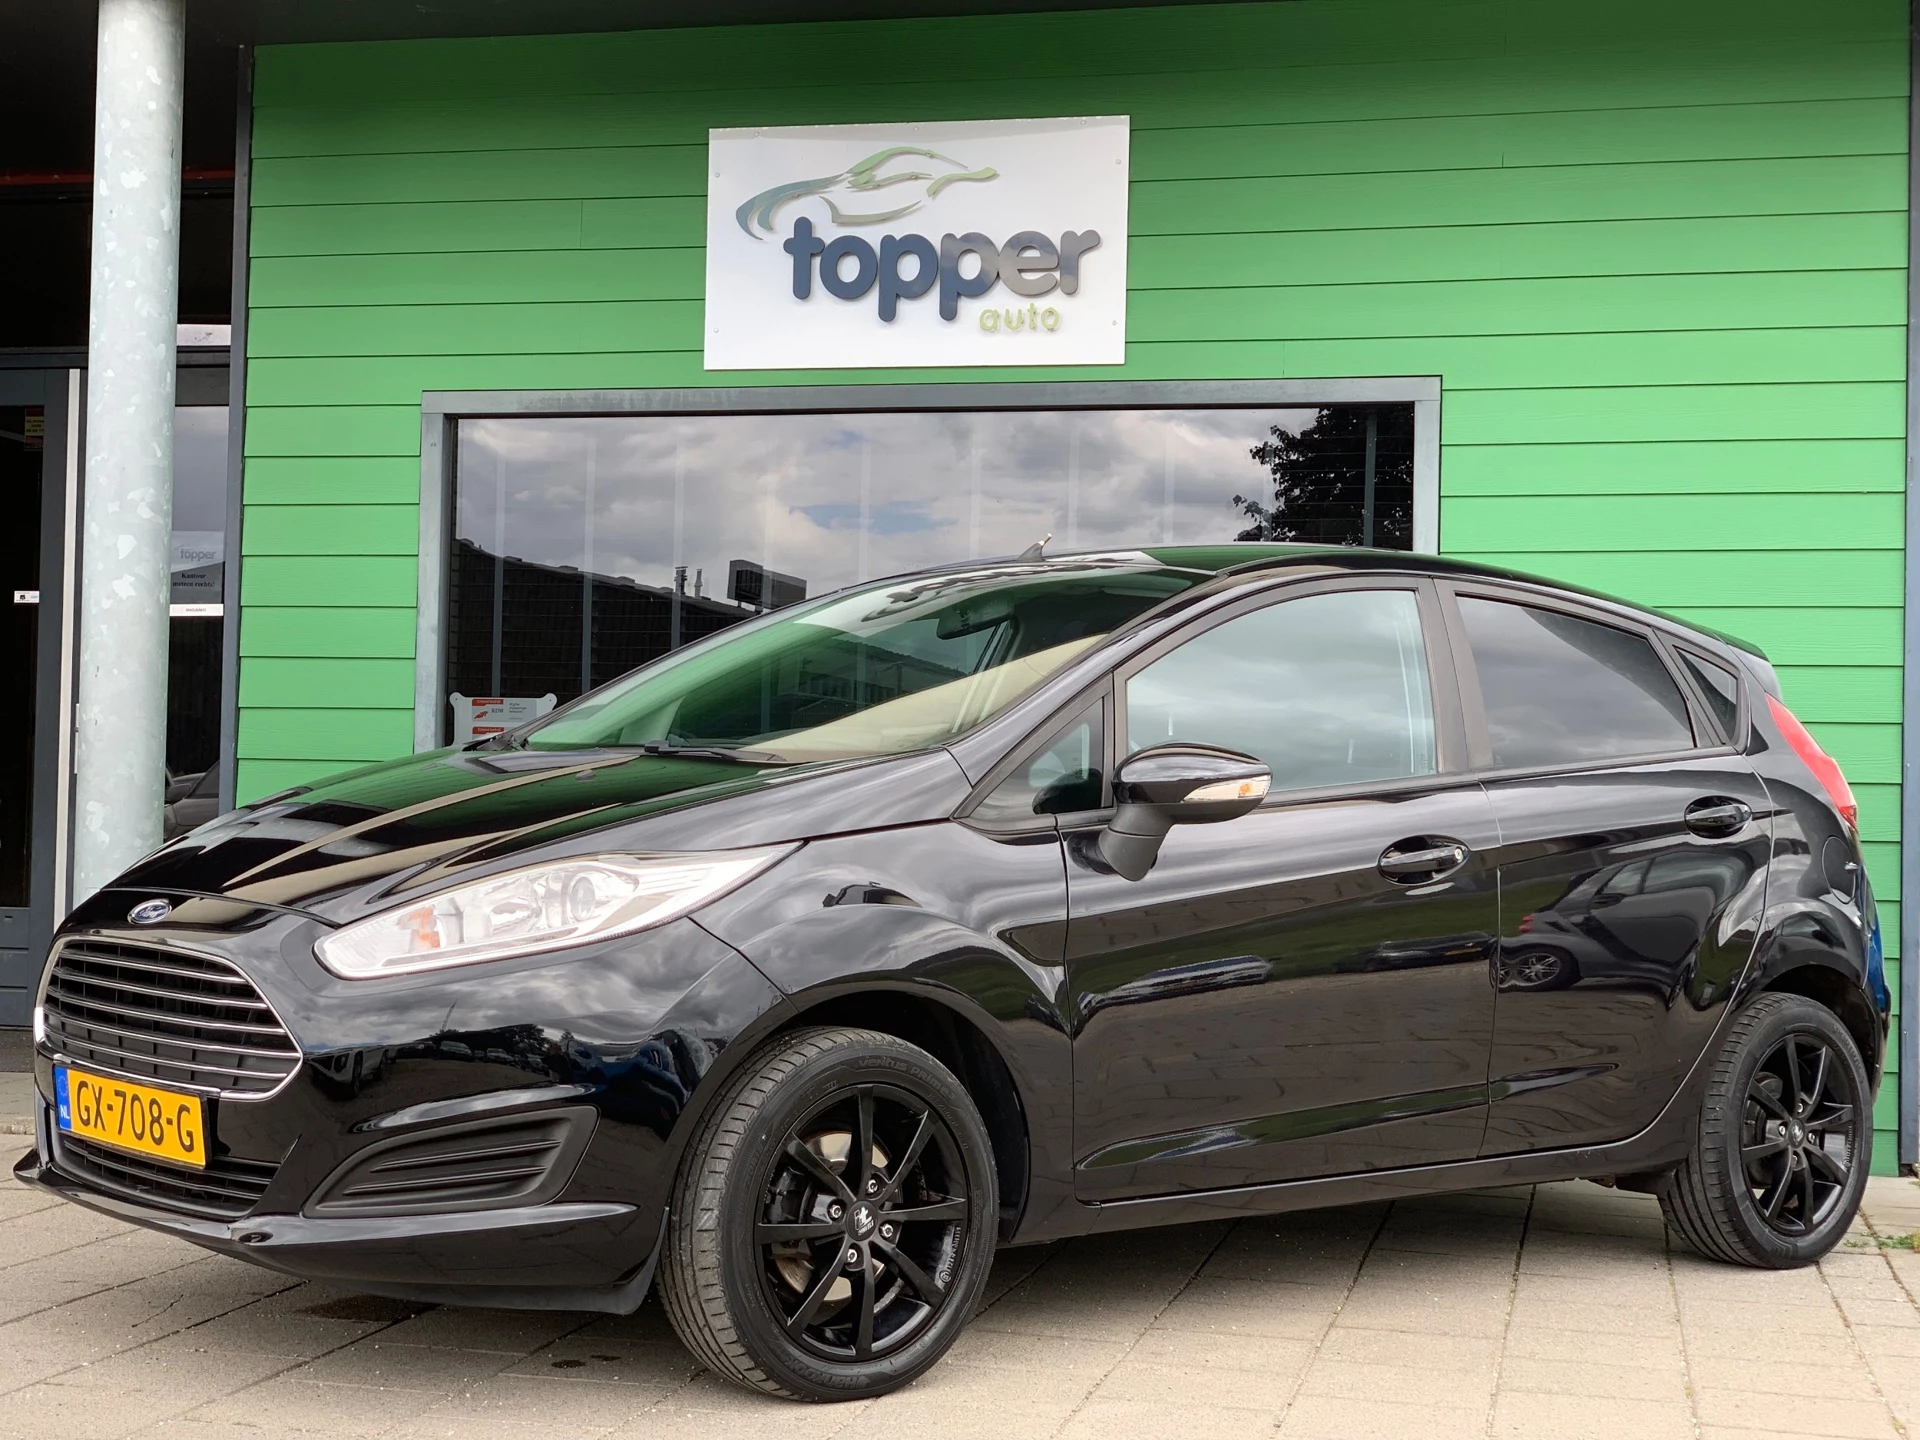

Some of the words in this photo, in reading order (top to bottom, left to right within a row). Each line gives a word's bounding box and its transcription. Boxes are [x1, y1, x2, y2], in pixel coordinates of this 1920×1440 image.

[783, 216, 1101, 322] topper
[979, 303, 1060, 332] auto
[180, 548, 216, 561] topper
[60, 1104, 70, 1120] NL
[77, 1081, 195, 1153] GX-708-G
